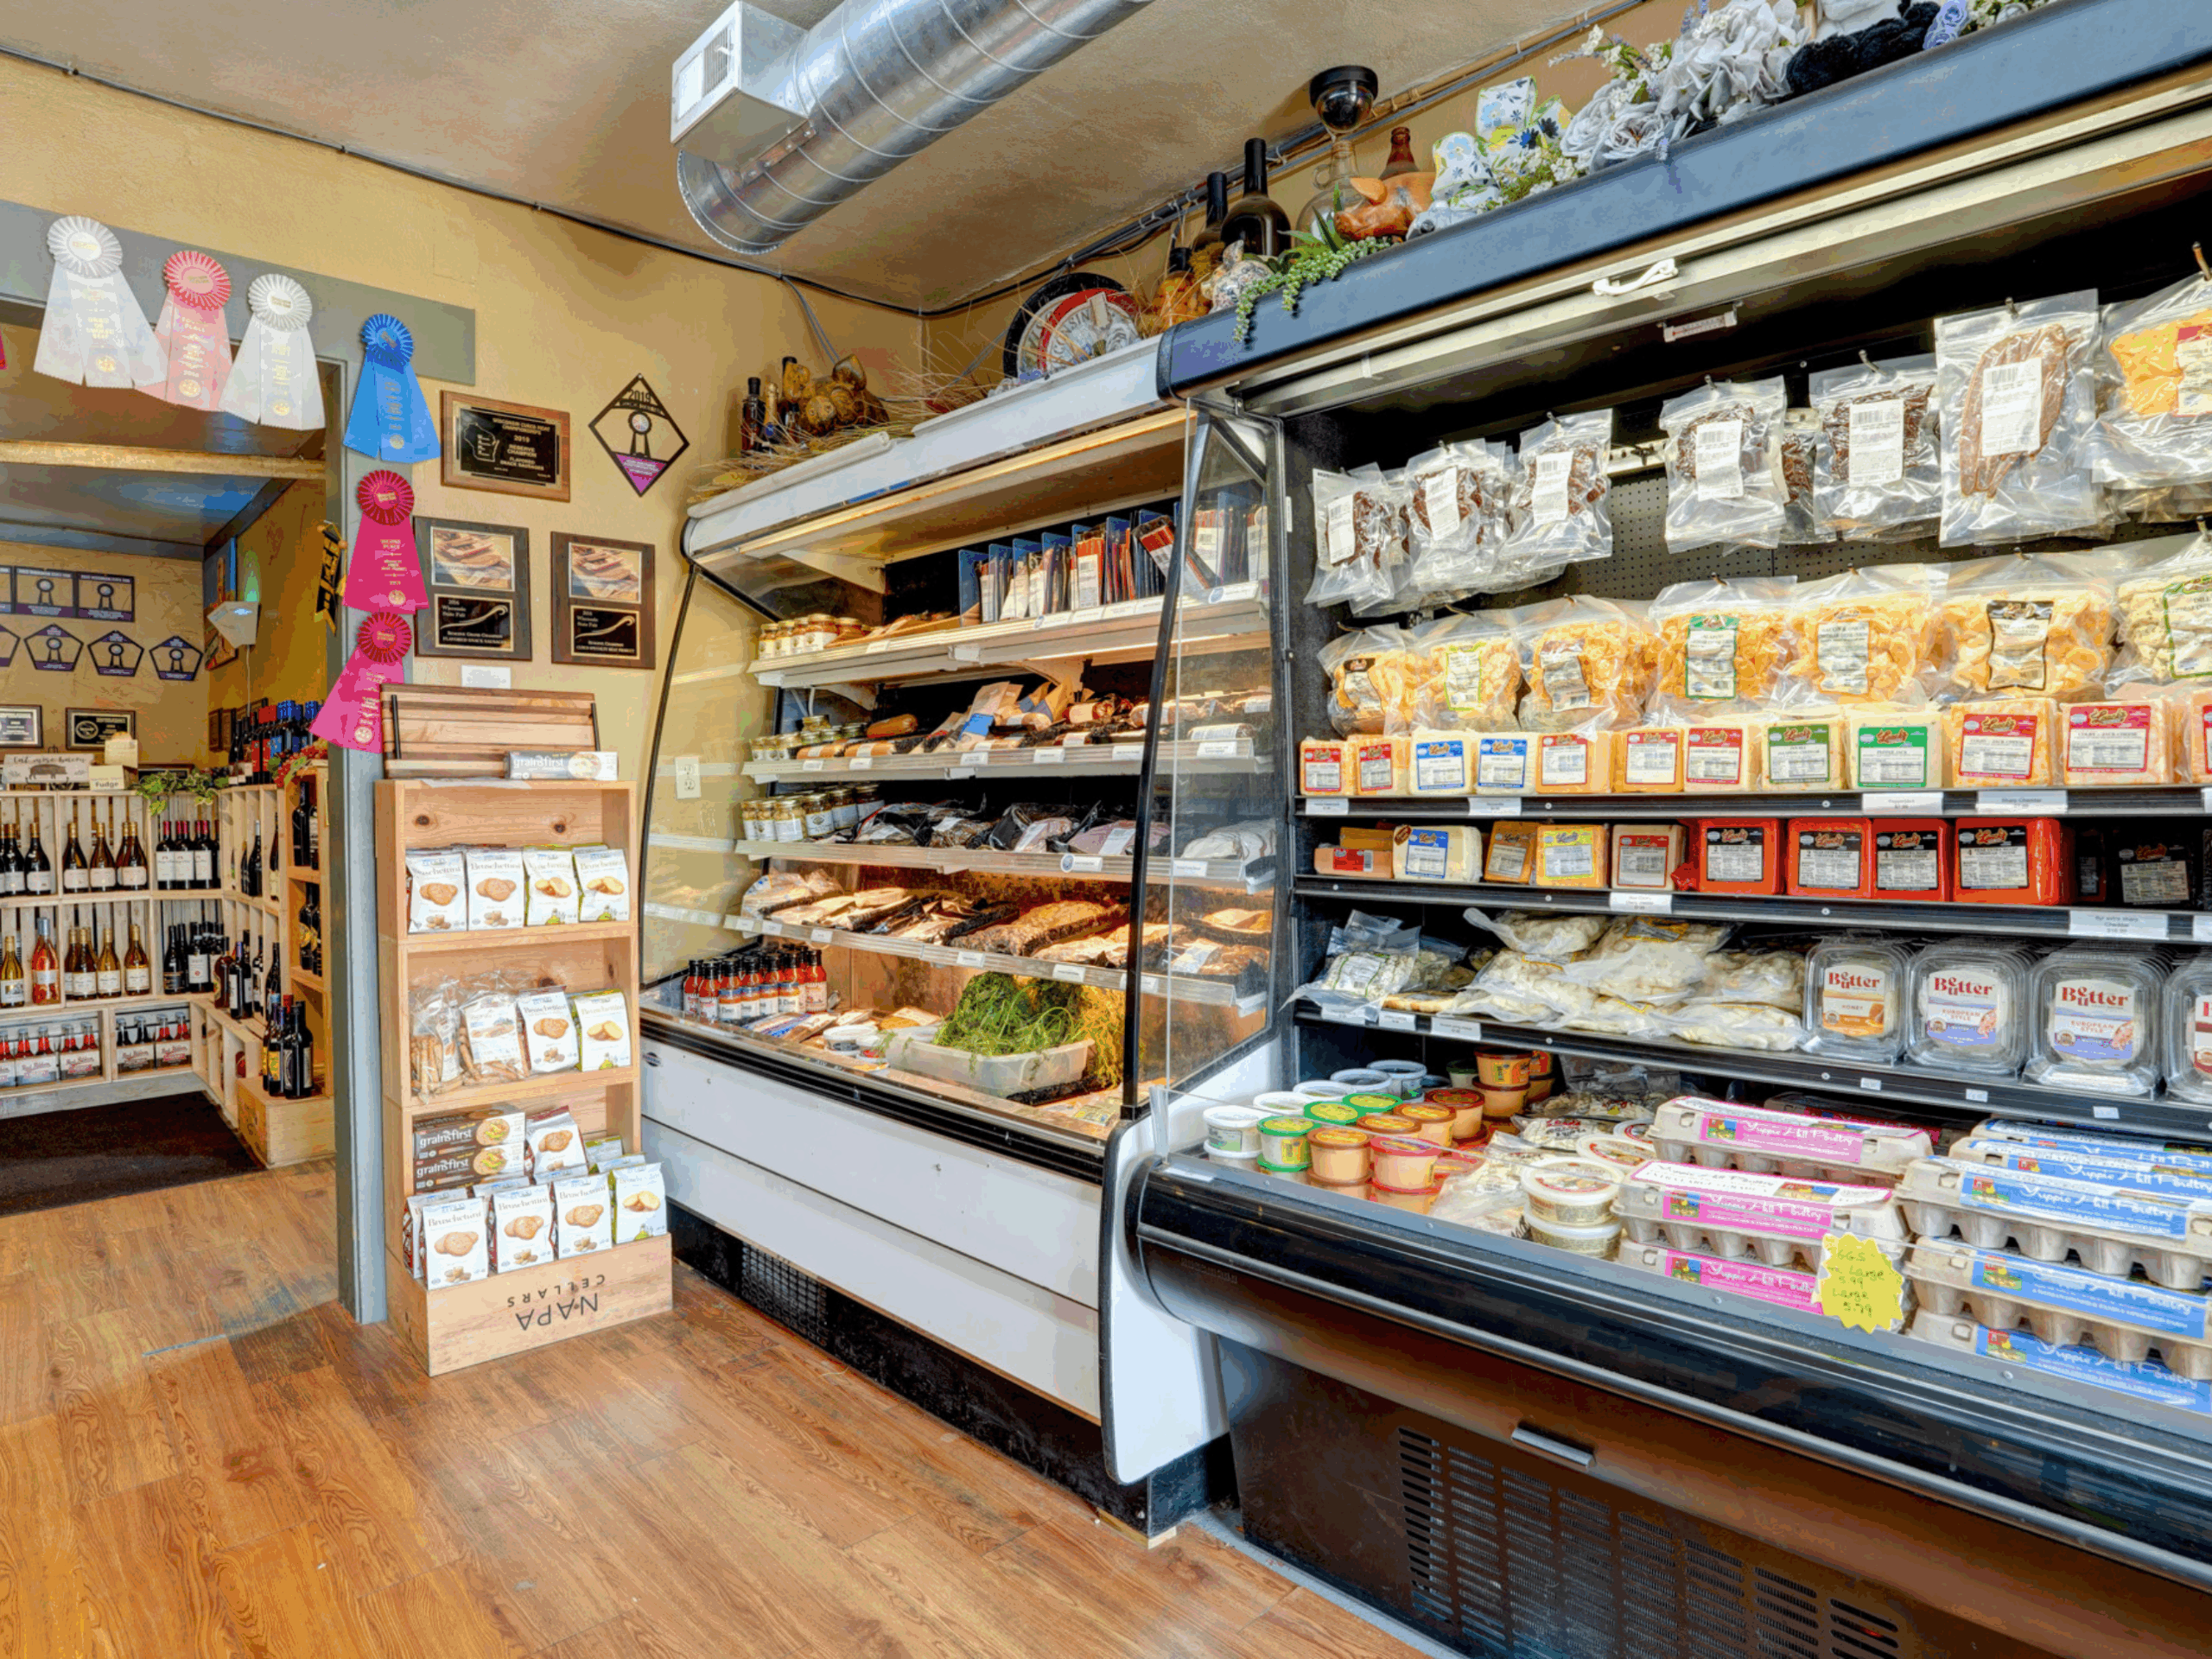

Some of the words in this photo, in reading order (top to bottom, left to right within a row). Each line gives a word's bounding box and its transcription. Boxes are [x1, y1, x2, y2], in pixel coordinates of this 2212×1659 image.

[629, 389, 651, 404] 2019
[513, 435, 531, 443] 2019
[506, 448, 537, 458] CHAMPION
[508, 444, 536, 453] RESERVE
[507, 1274, 606, 1308] CELLARS
[515, 1293, 599, 1332] NAPA
